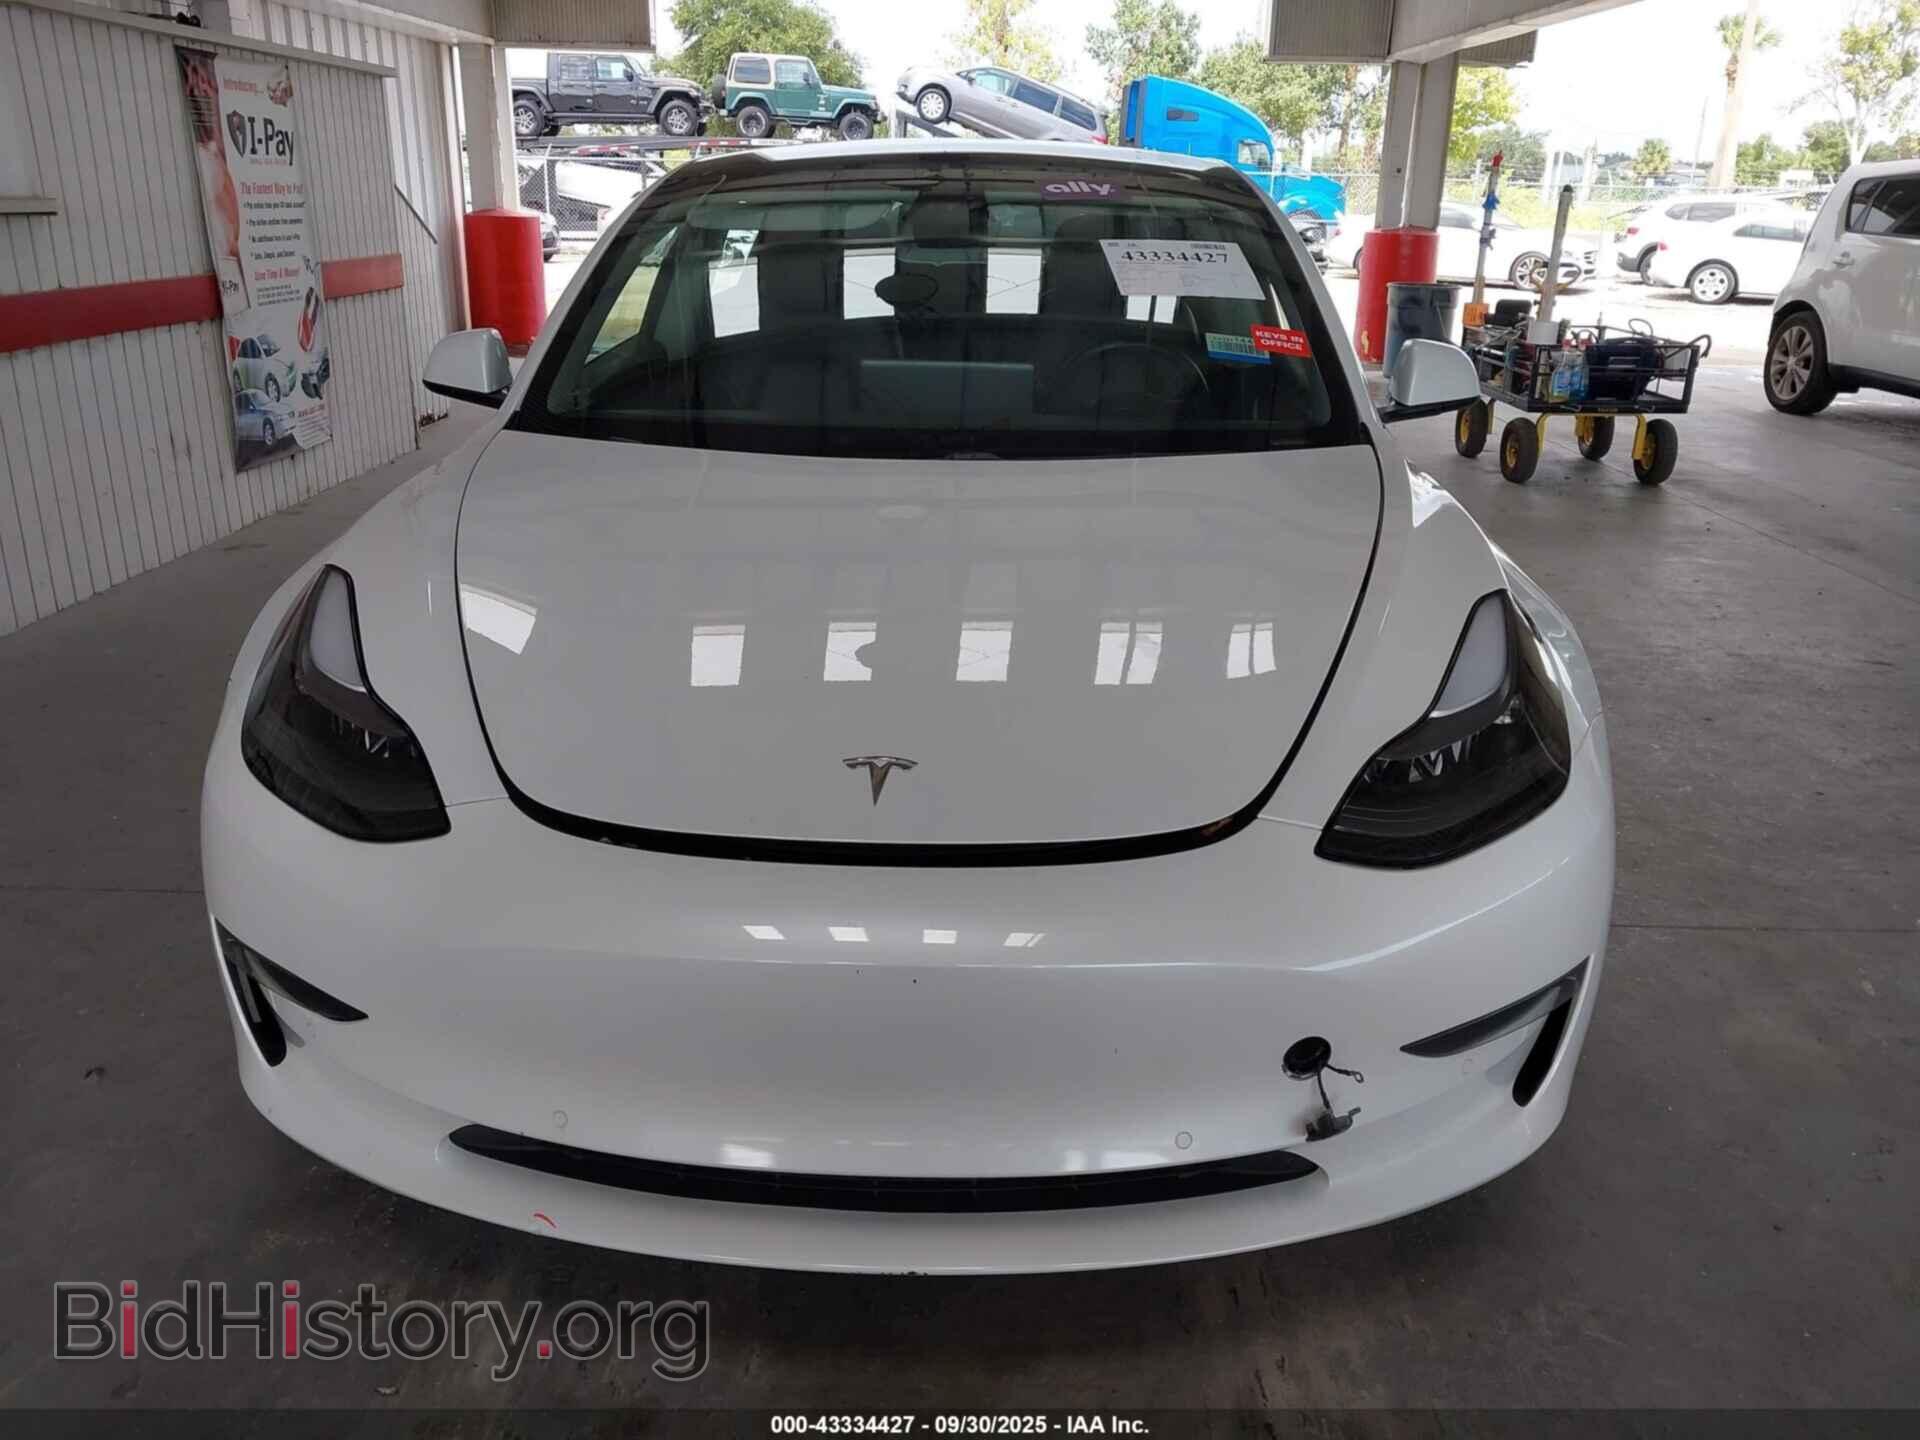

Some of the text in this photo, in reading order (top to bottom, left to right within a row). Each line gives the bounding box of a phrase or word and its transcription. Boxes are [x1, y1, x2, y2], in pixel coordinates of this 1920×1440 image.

[247, 116, 294, 166] I-Pay
[1045, 181, 1111, 196] ally
[1121, 250, 1228, 263] 43334427
[1255, 330, 1288, 341] KEYS
[1290, 335, 1304, 344] IN
[1260, 339, 1303, 351] OFFICE
